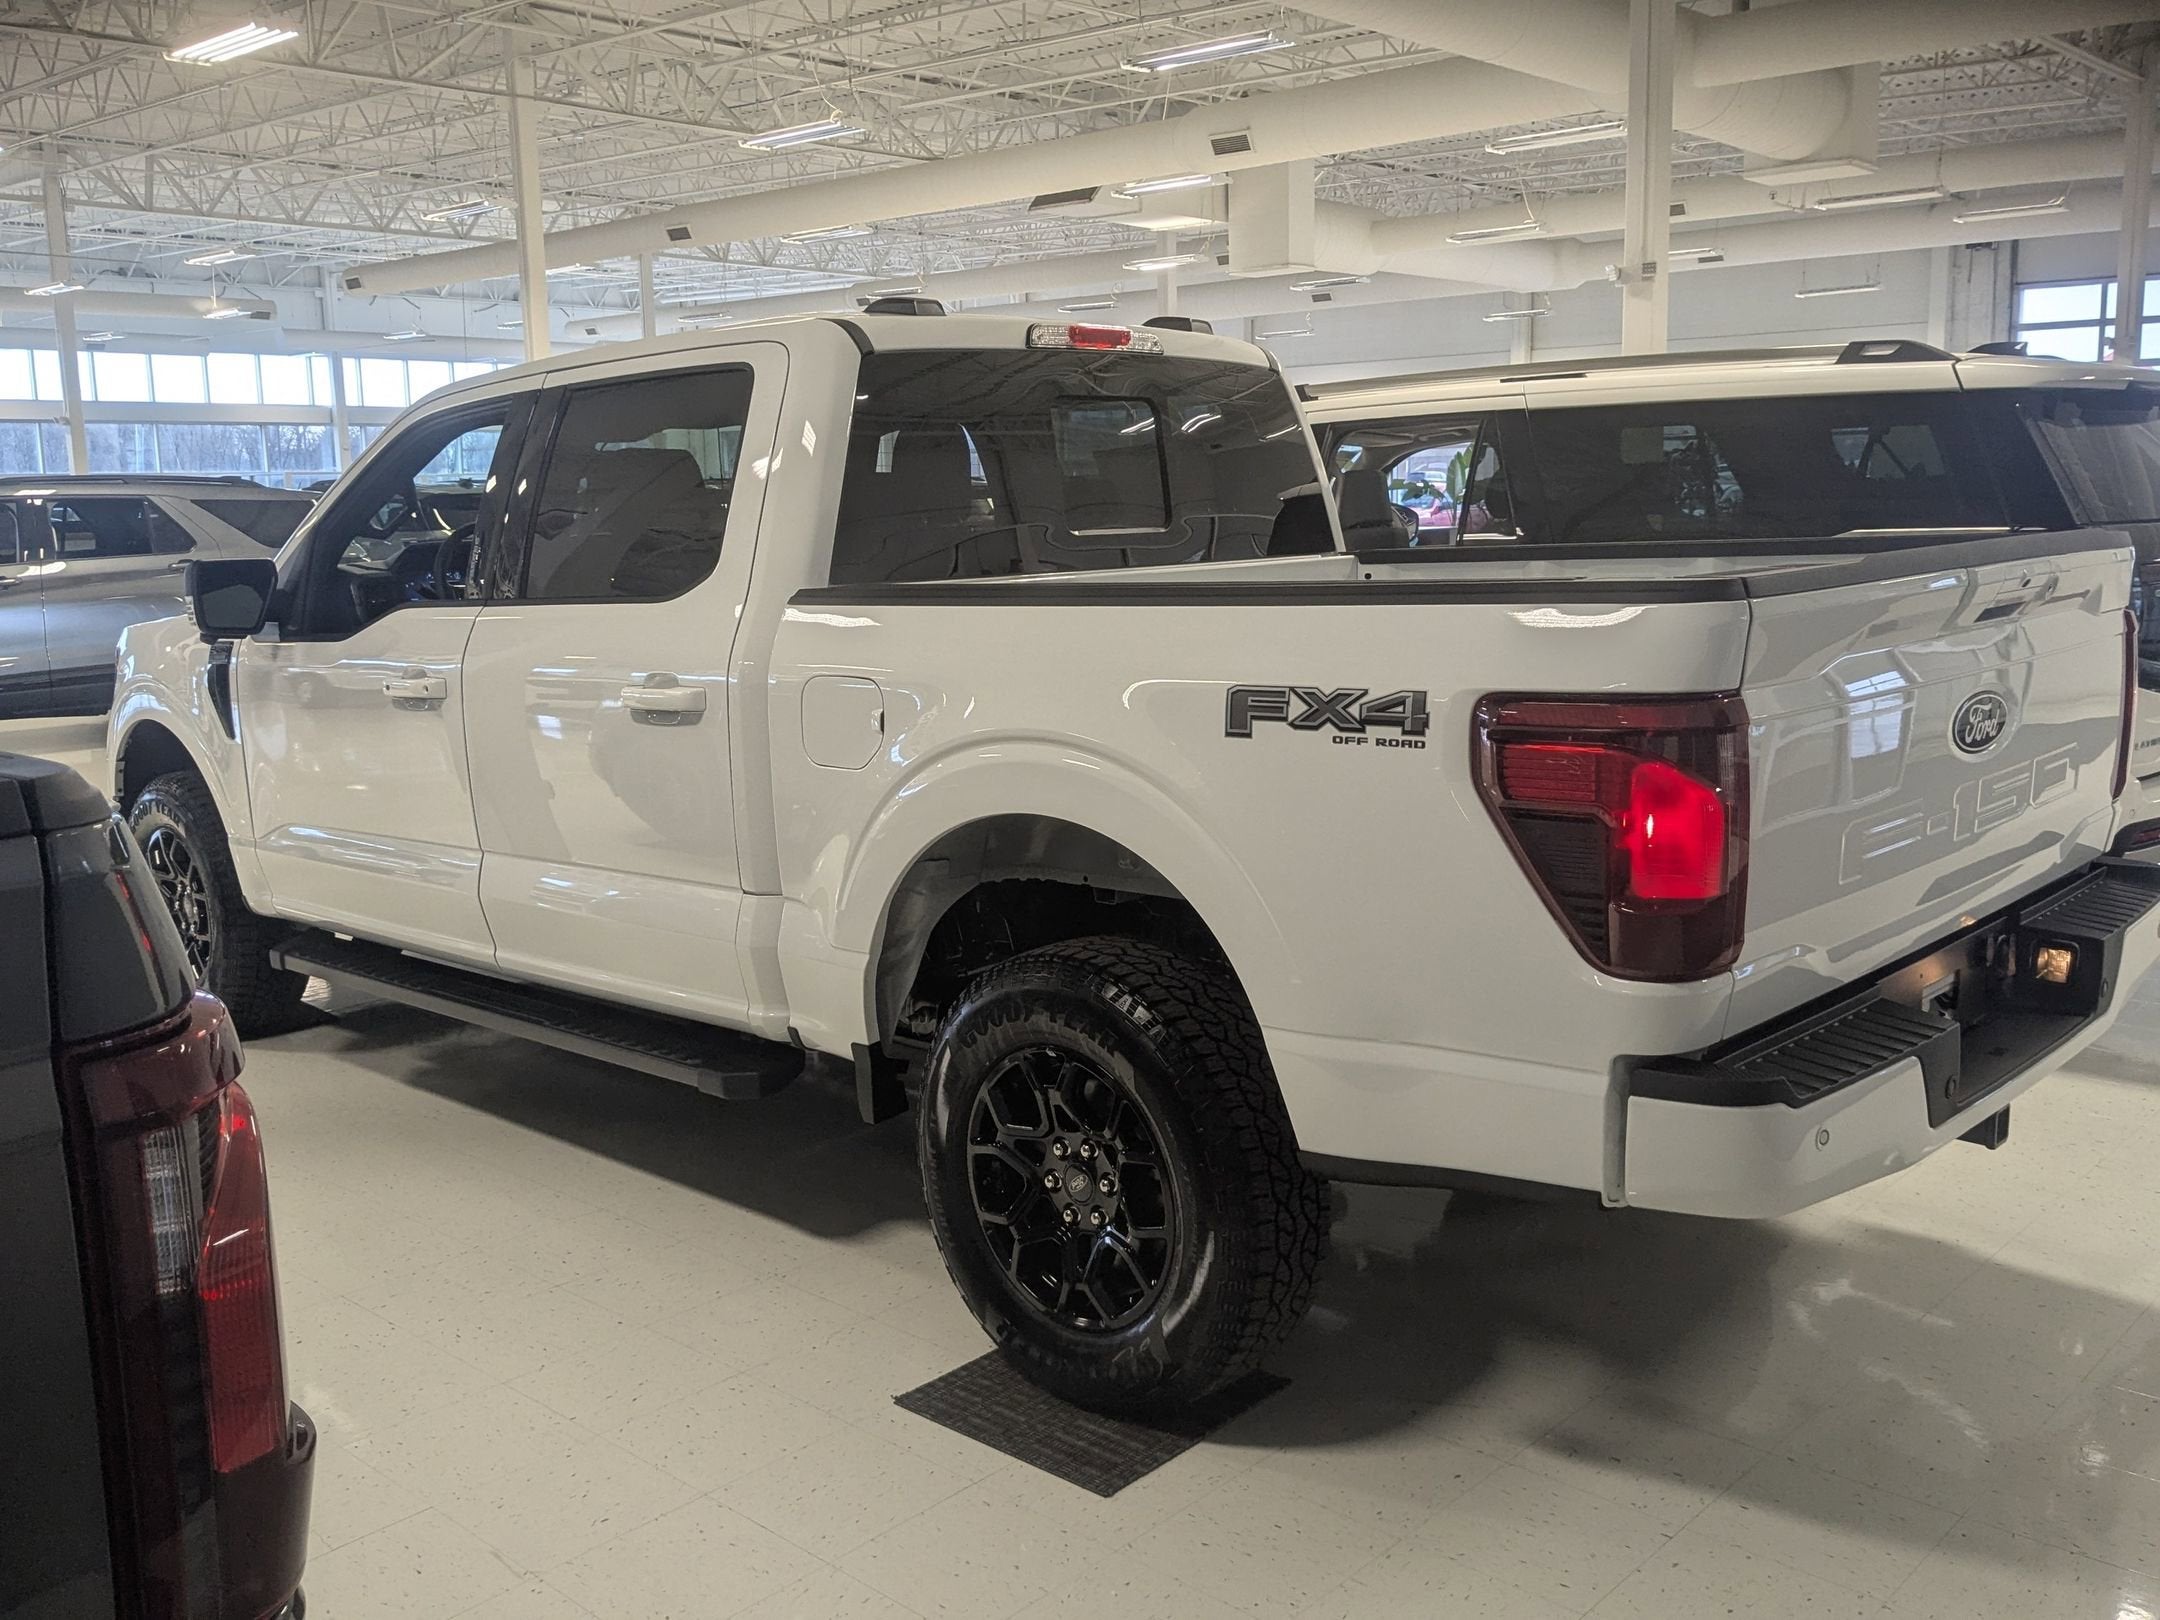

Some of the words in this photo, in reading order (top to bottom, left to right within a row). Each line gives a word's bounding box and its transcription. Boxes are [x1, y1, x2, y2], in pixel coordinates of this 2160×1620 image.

[1224, 684, 1430, 739] FX4
[1964, 702, 2001, 744] Ford
[1332, 735, 1369, 746] OFF
[1375, 737, 1426, 750] ROAD
[1838, 742, 2080, 885] F-150
